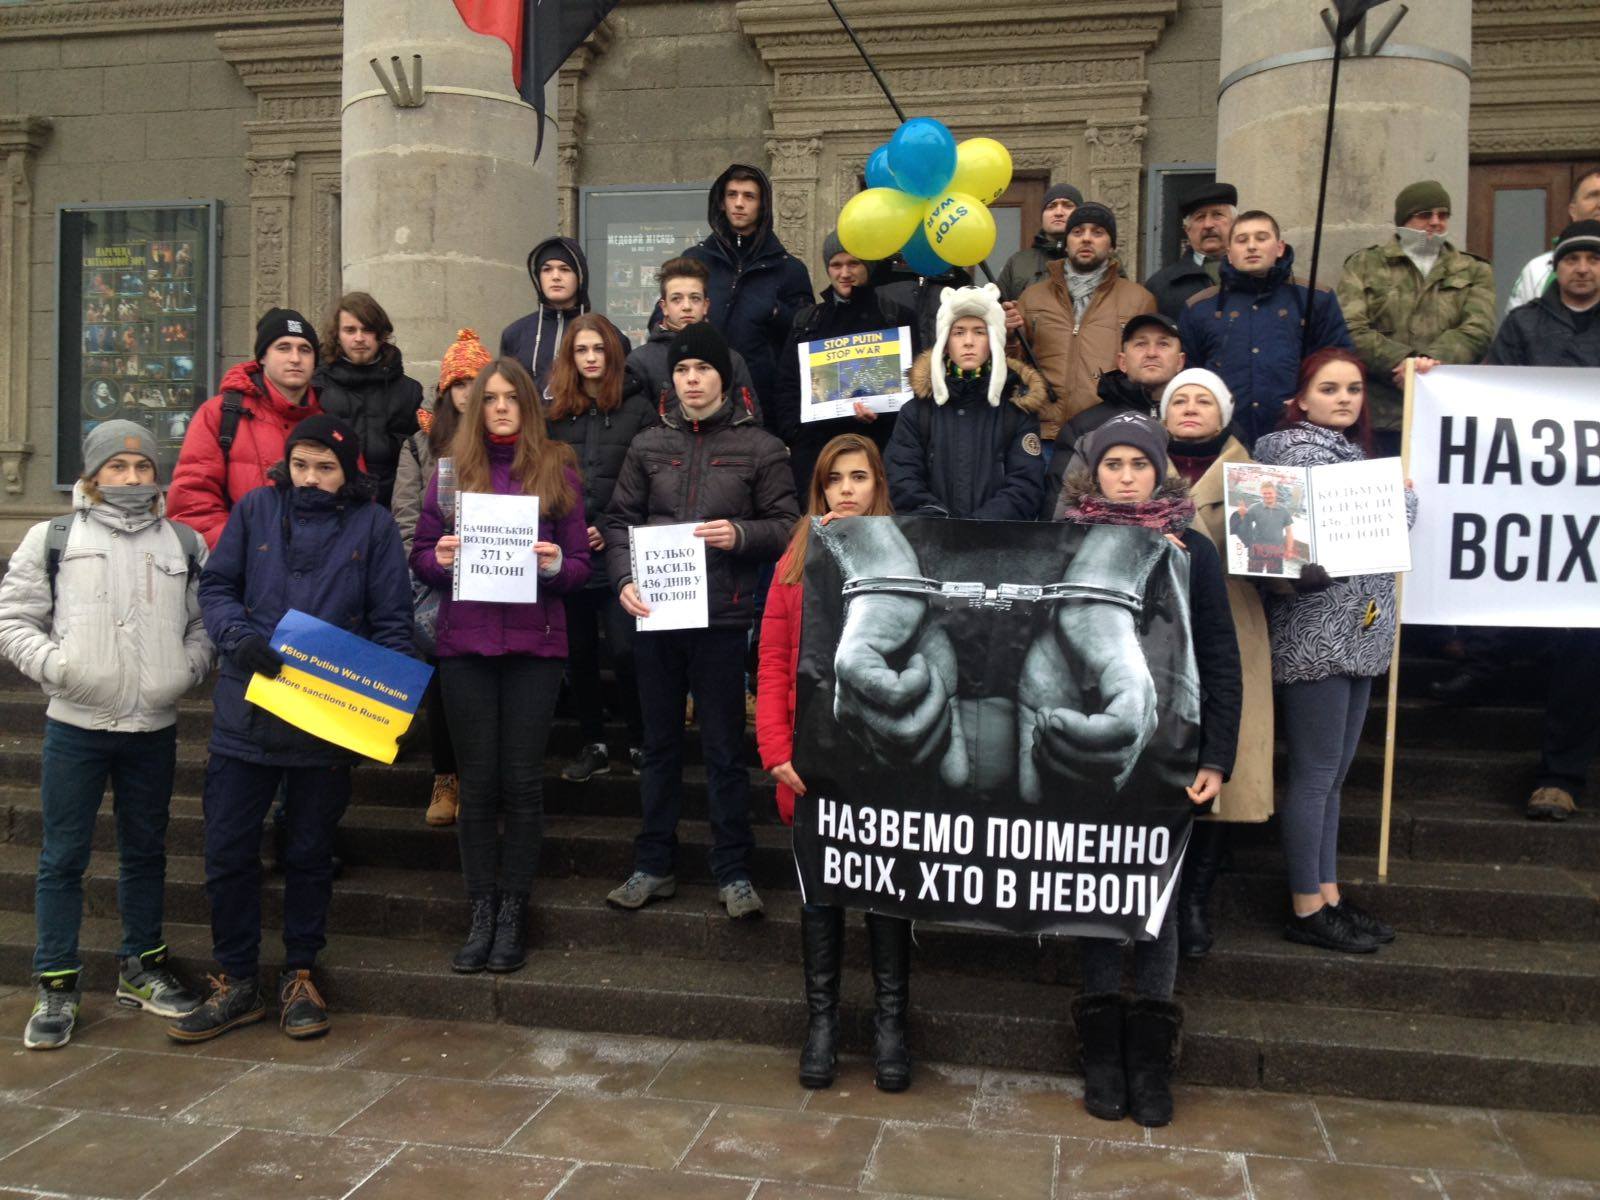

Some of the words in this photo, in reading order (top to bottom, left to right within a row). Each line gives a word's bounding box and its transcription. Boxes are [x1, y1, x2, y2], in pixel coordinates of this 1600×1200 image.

[927, 198, 955, 228] WAR
[935, 206, 968, 244] STOP
[823, 337, 850, 351] STOP
[852, 332, 883, 346] PUTIN
[826, 348, 851, 361] STOP
[855, 345, 881, 356] WAR
[463, 524, 534, 536] БАЧИНСЬКИЙ
[463, 535, 533, 548] ВОЛОДИМИР
[480, 549, 501, 561] 371
[505, 551, 515, 561] У
[645, 547, 695, 561] ГУЛЬКО
[470, 563, 525, 577] ПОЛОНІ
[646, 562, 696, 575] ВАСИЛЬ
[642, 579, 661, 589] 436
[663, 576, 692, 588] ДНІВ
[694, 575, 702, 586] У
[650, 590, 697, 603] ПОЛОНІ
[279, 643, 308, 662] #Stop
[310, 655, 340, 674] Putins
[341, 668, 360, 682] War
[362, 676, 372, 686] in
[372, 680, 409, 702] Ukraine
[275, 675, 301, 690] More
[302, 685, 346, 708] sanctions
[347, 703, 358, 713] to
[359, 707, 390, 726] Russia
[816, 798, 976, 856] НАЗВЕМО
[986, 816, 1171, 866] ПОІМЕННО
[823, 846, 907, 901] ВСІХ,
[917, 861, 984, 906] ХТО
[996, 868, 1018, 910] В
